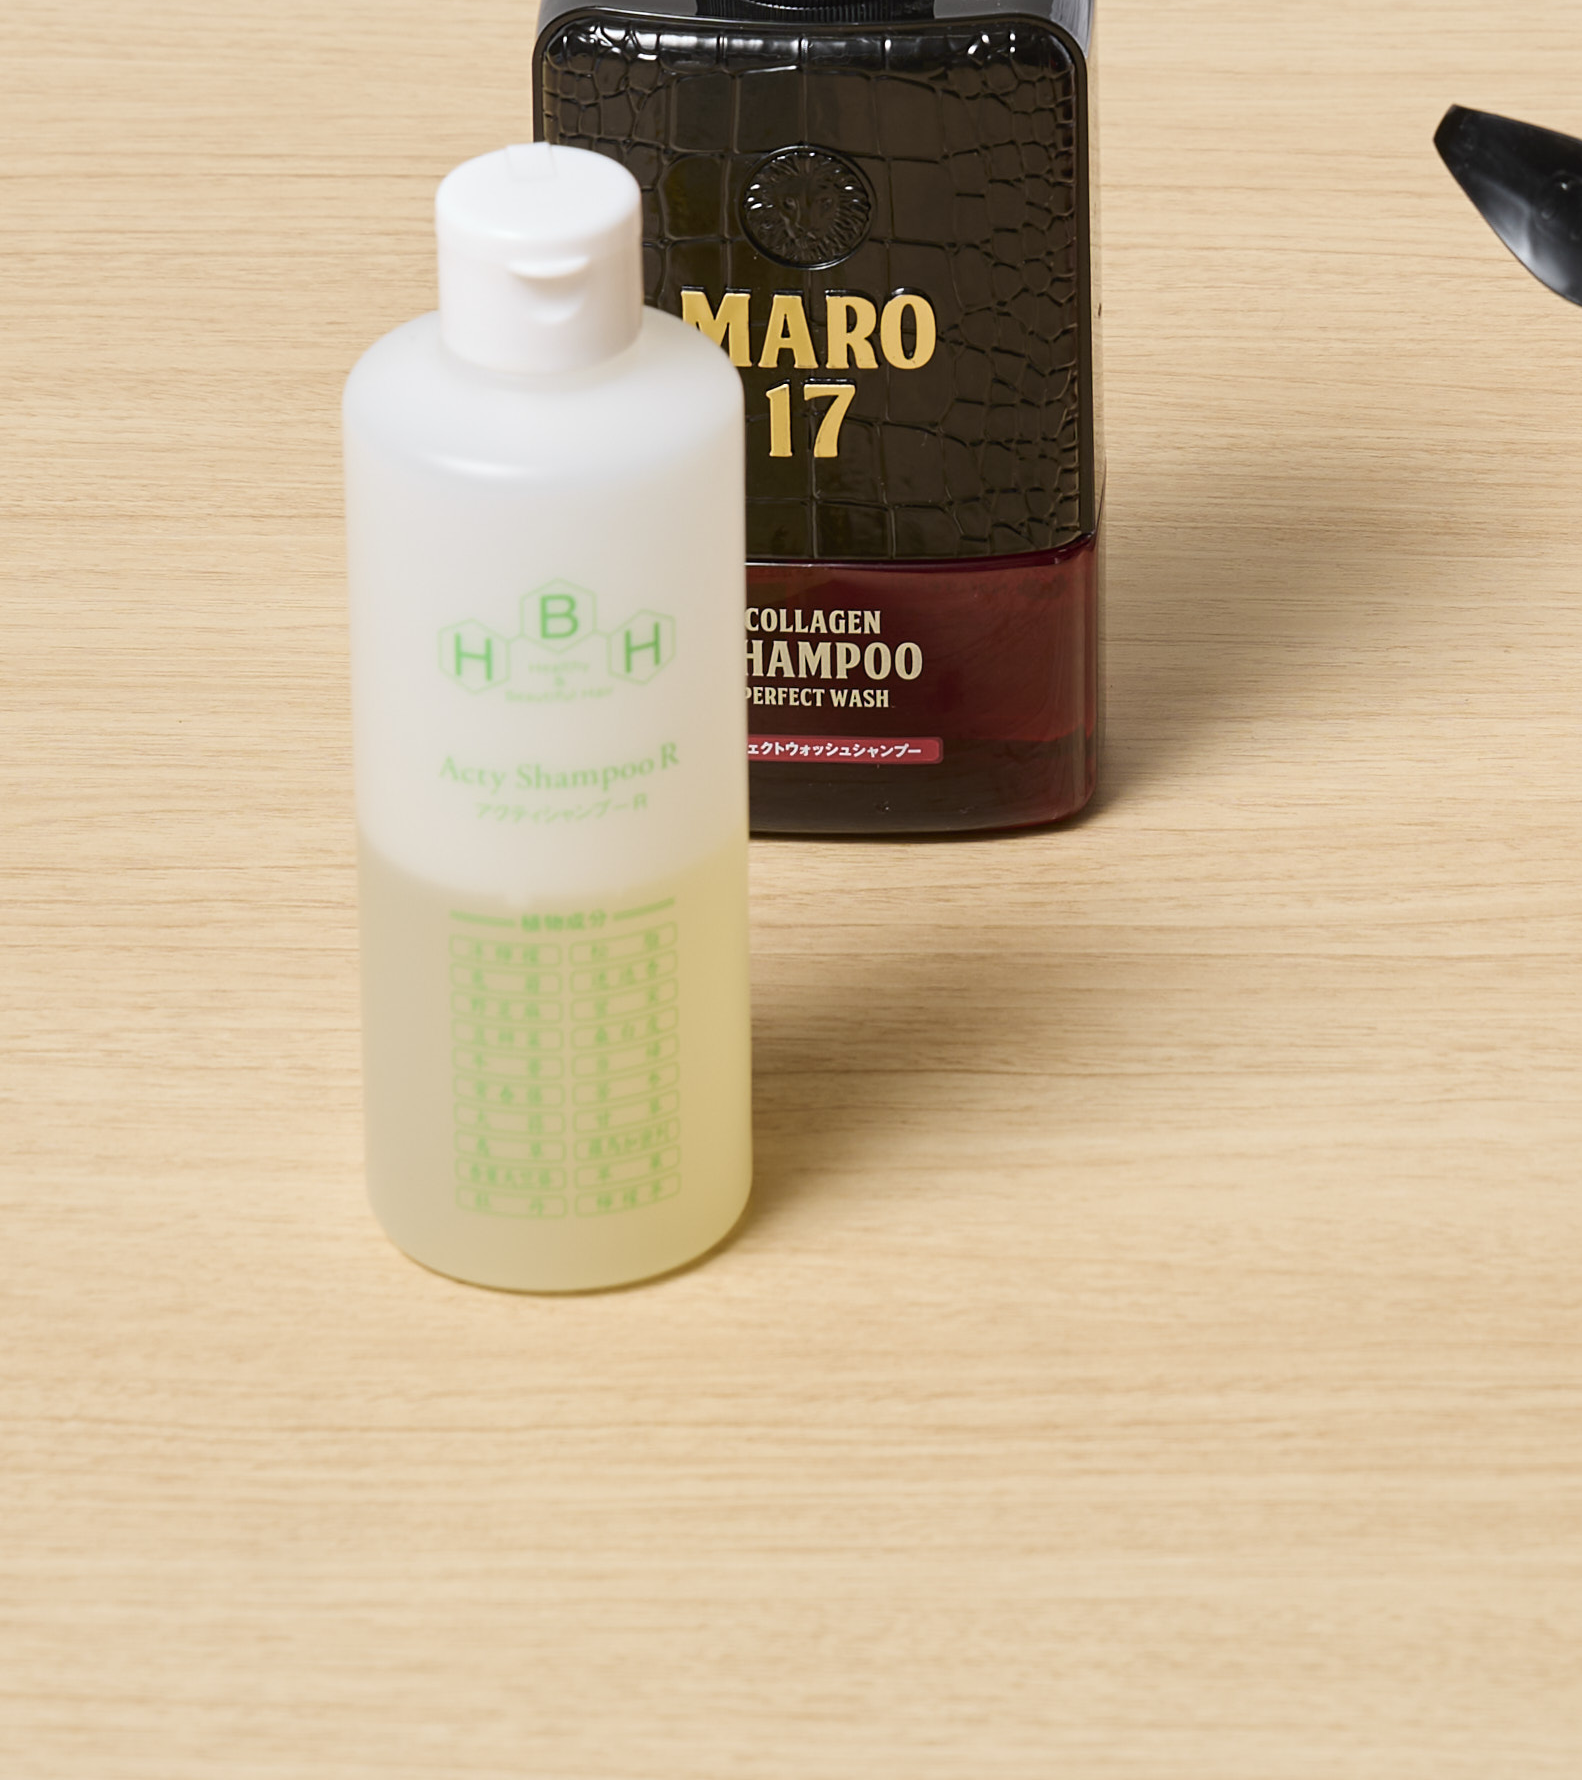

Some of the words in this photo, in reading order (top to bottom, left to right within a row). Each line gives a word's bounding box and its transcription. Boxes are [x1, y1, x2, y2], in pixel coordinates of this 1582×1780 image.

[681, 289, 937, 370] MARO
[765, 383, 856, 458] 17
[744, 607, 881, 634] COLLAGEN
[744, 639, 923, 680] HAMPOO
[830, 689, 889, 708] WASH
[437, 755, 507, 796] Acty
[514, 757, 656, 793] Shampoo
[659, 741, 680, 771] R
